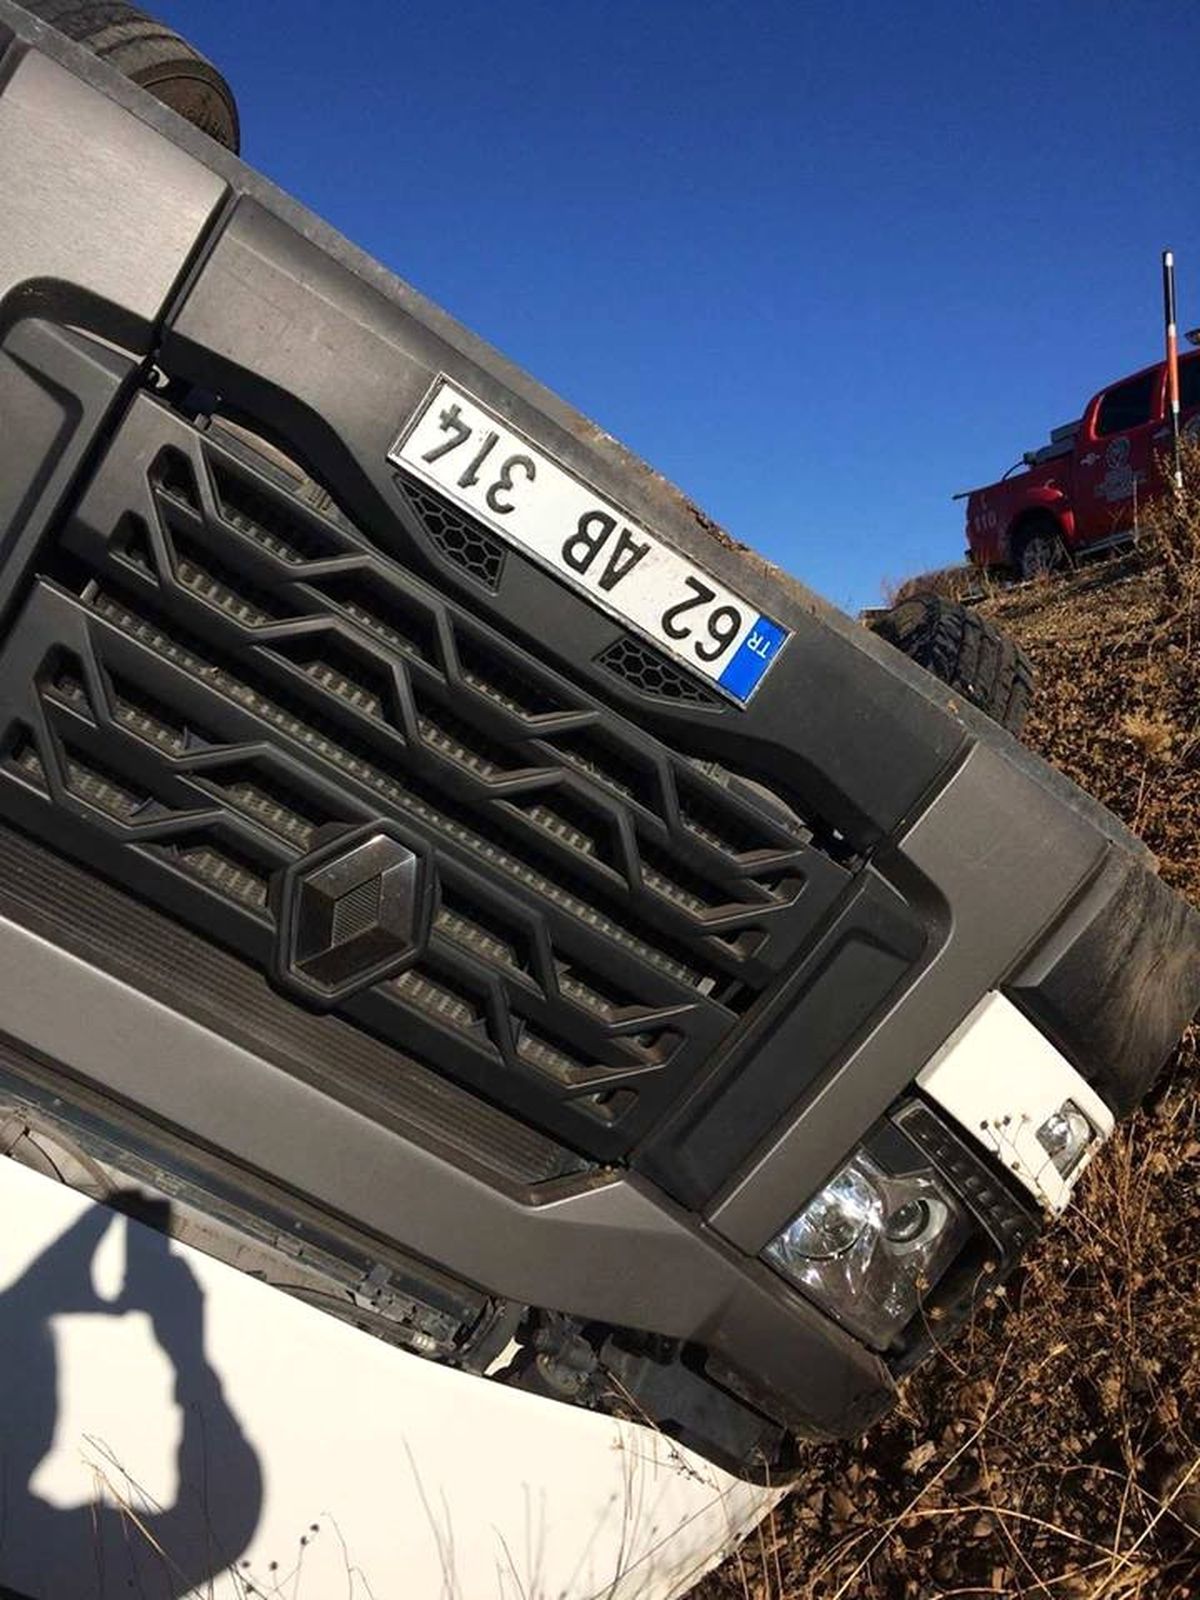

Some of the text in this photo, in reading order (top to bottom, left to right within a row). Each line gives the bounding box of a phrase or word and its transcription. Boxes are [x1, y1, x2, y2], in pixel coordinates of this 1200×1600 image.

[422, 404, 771, 662] TR 62 AB 314
